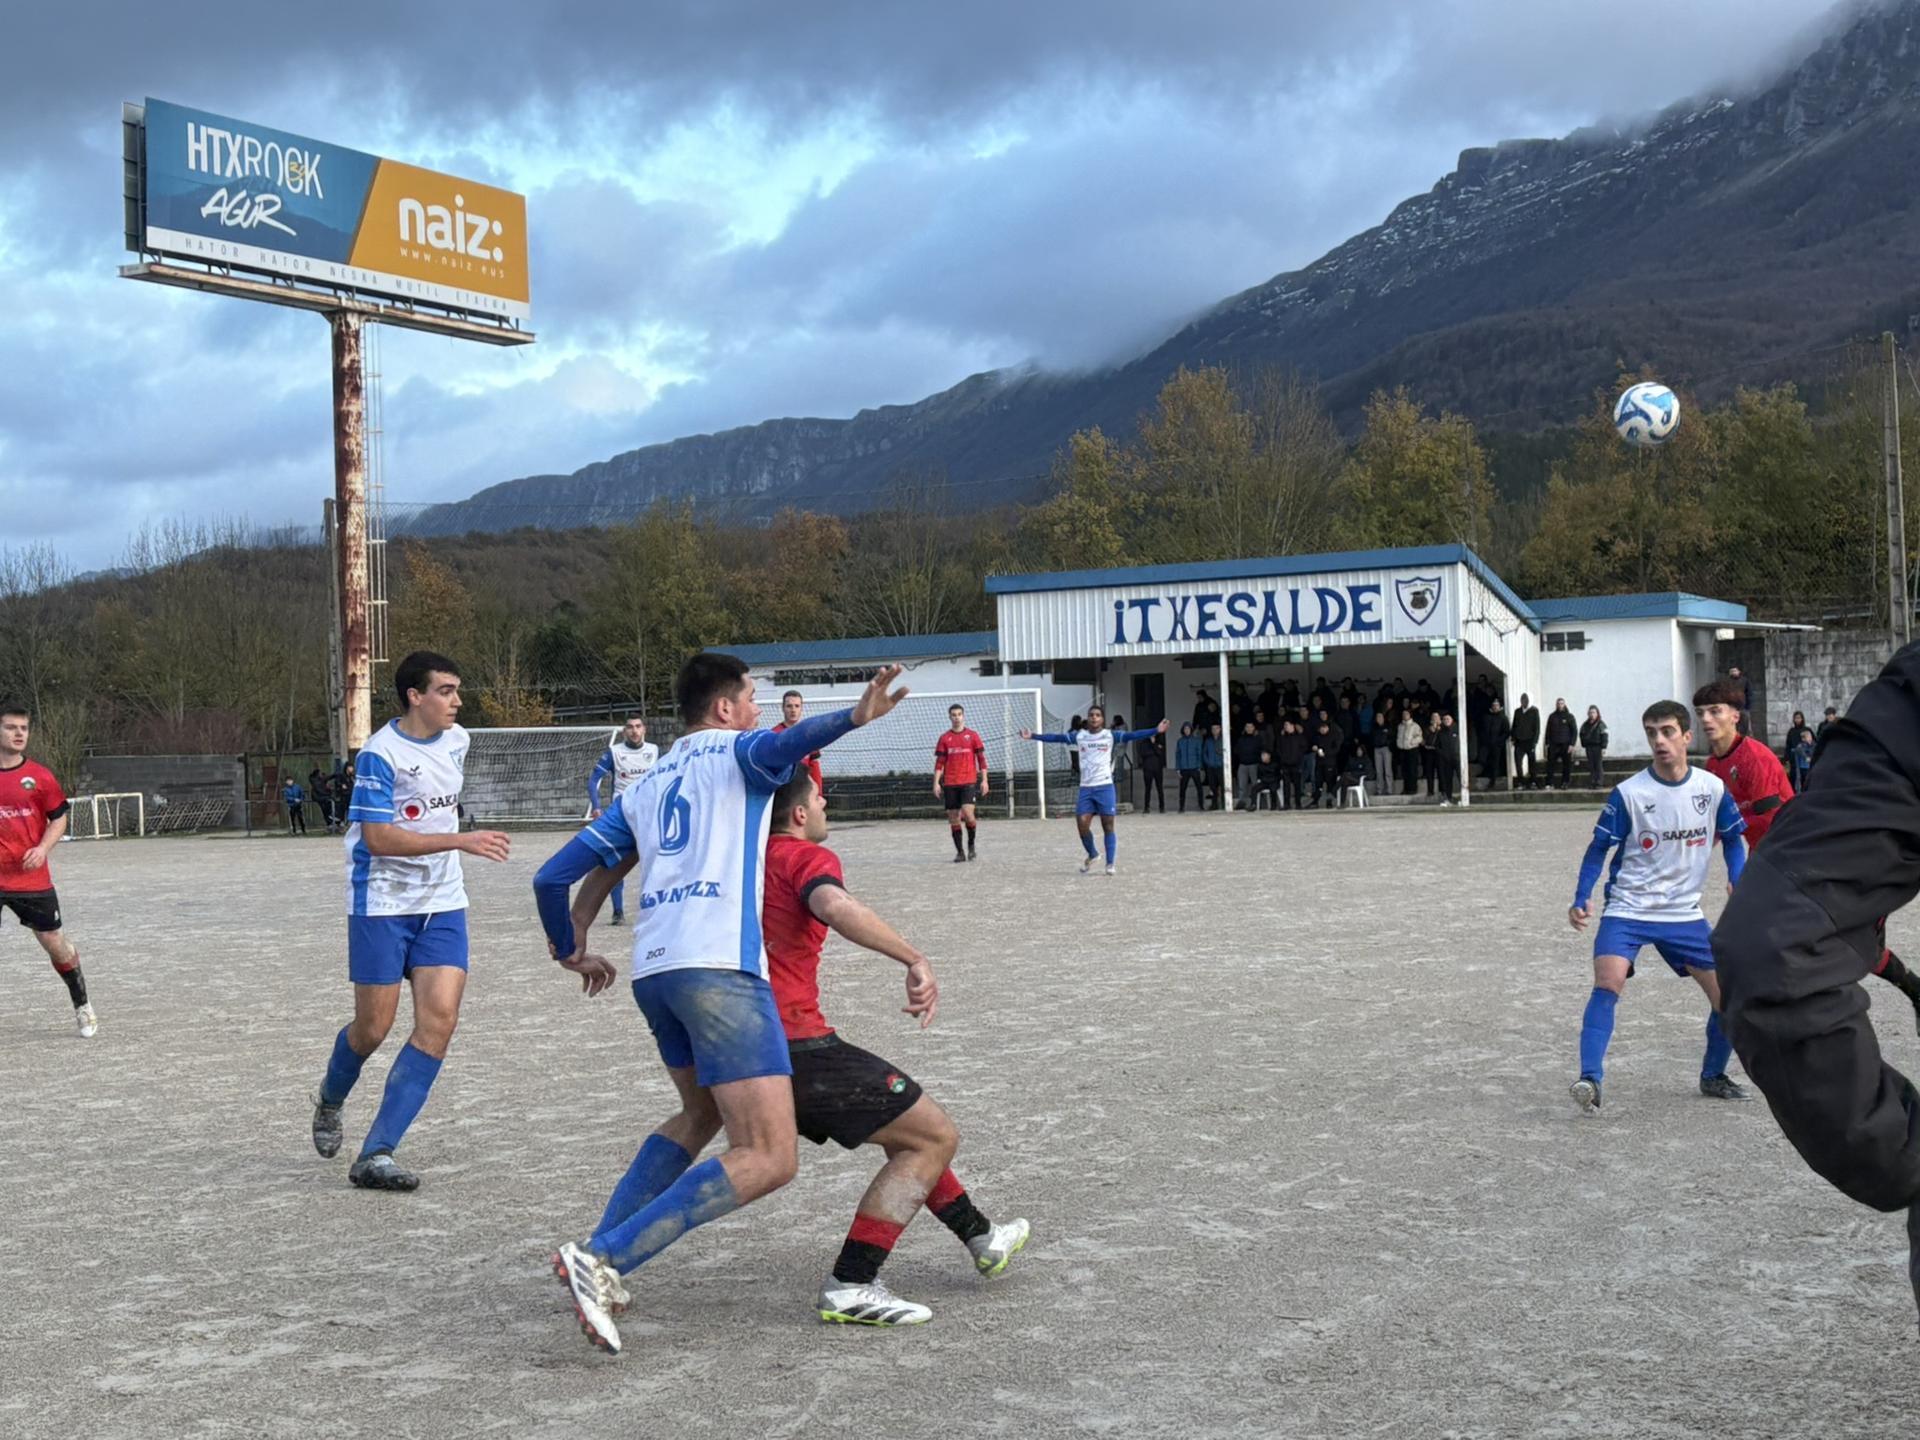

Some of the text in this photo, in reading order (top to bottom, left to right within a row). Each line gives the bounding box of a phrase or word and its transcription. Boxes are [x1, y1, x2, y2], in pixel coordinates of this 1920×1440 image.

[200, 187, 297, 236] AGUR
[185, 237, 239, 258] HATOR
[259, 251, 311, 272] HATOR
[400, 246, 505, 279] www.naiz.eus
[658, 775, 691, 857] 6
[1662, 826, 1708, 842] SAKANA
